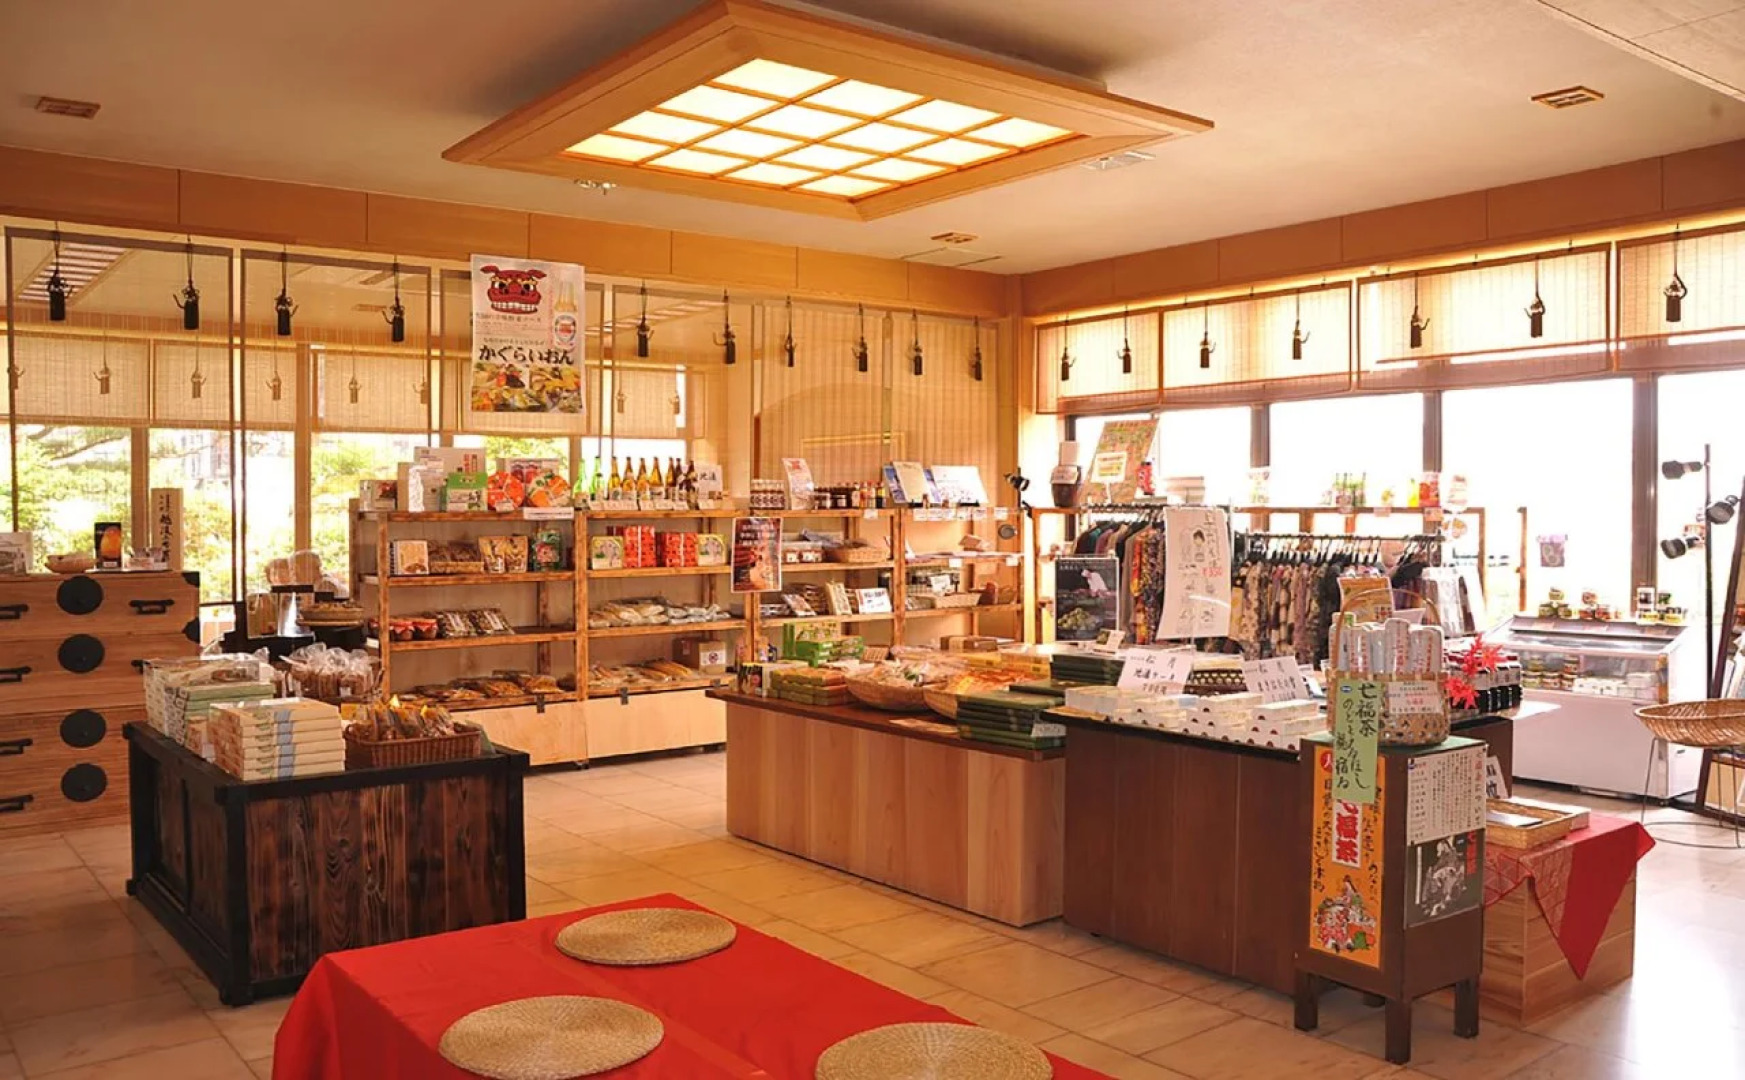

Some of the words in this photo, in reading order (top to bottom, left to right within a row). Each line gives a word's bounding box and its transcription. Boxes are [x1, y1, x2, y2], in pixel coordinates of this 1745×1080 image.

[479, 345, 574, 365] かぐらいおん
[1355, 682, 1378, 737] 七福茶
